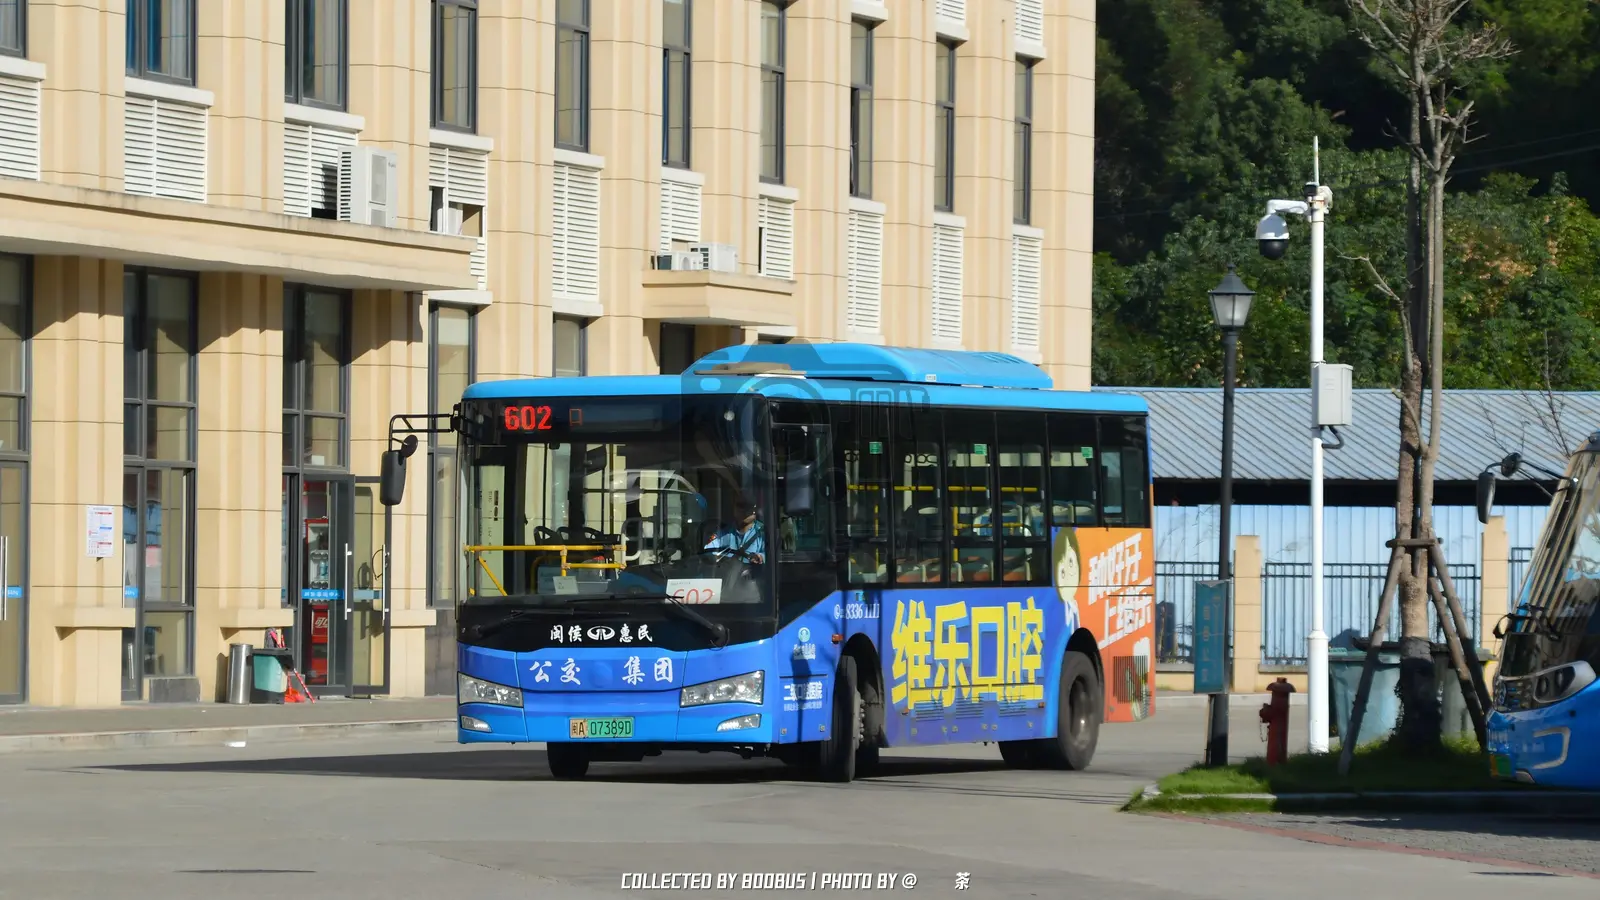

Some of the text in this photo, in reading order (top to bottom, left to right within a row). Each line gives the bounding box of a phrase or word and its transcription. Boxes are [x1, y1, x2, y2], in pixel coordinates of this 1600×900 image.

[504, 405, 552, 430] 602
[550, 623, 653, 643] 闽侯 惠民
[891, 596, 1044, 709] 维乐口腔
[529, 656, 673, 685] 公交 集团
